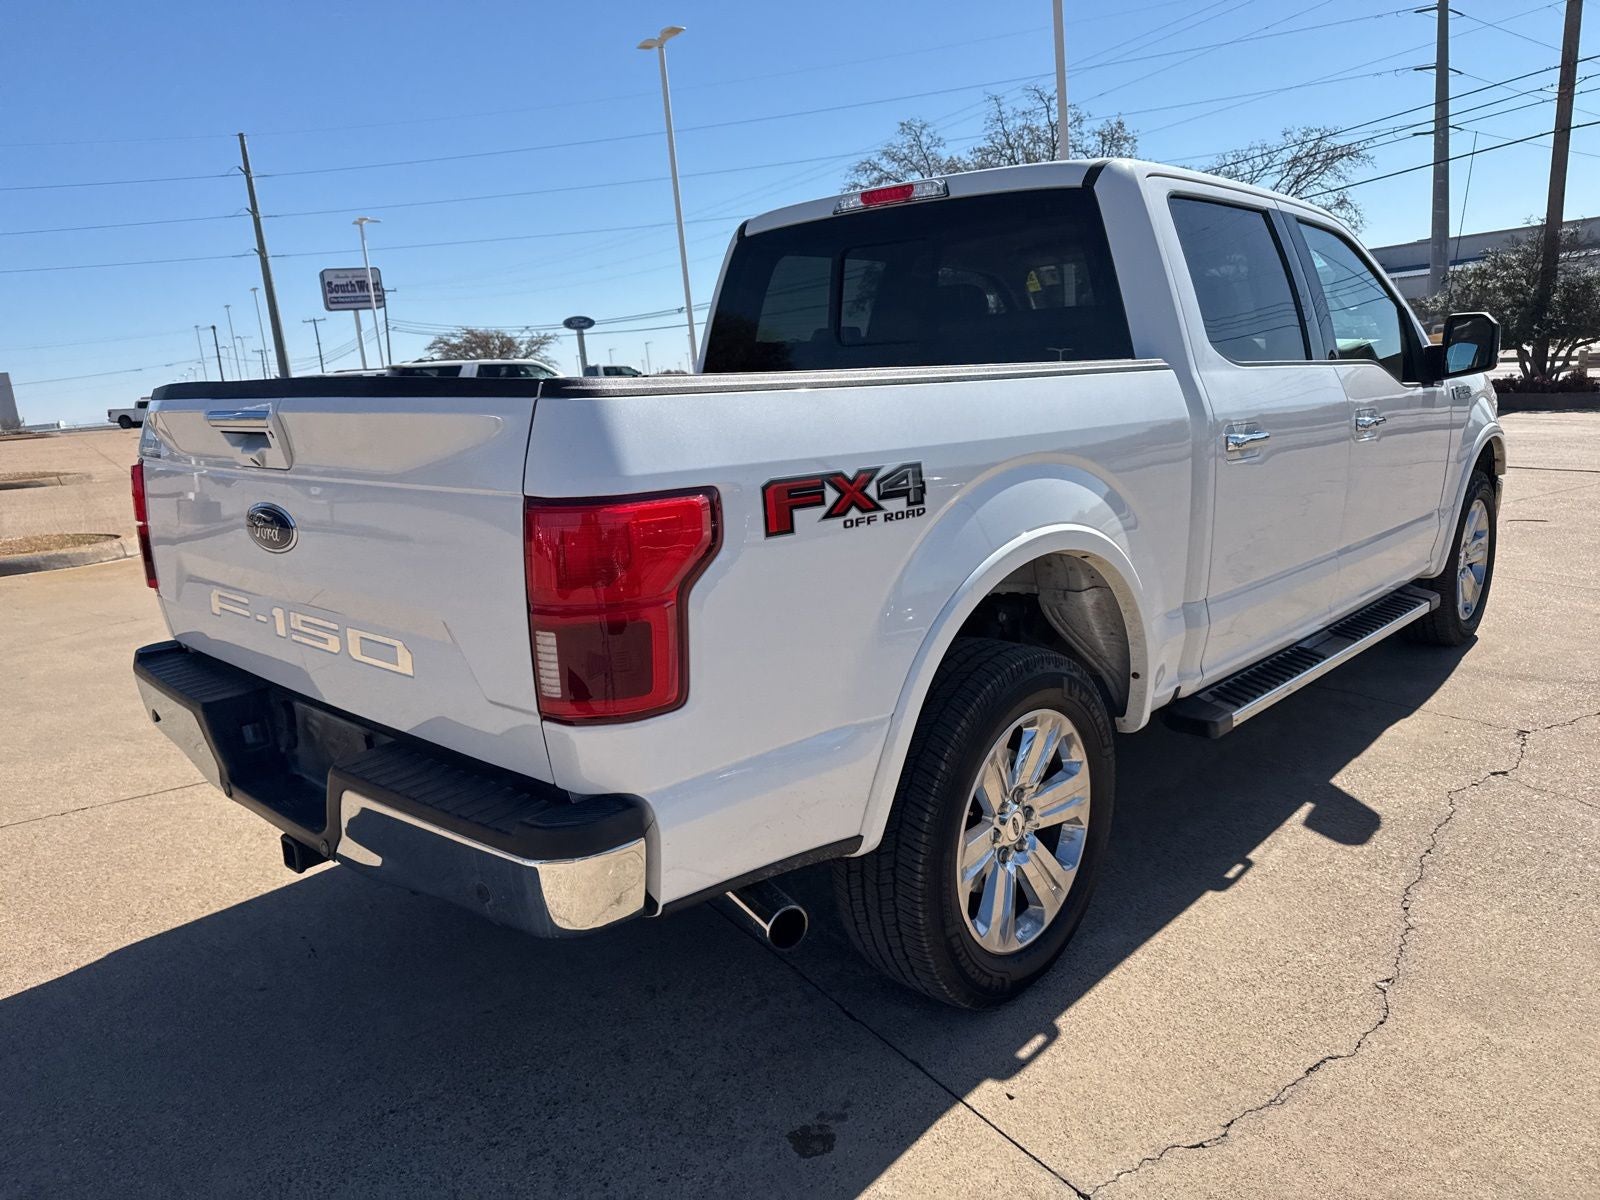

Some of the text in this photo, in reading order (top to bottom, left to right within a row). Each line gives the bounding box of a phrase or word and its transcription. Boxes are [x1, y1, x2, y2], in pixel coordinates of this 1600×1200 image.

[252, 512, 280, 542] Ford
[761, 461, 926, 539] FX4
[843, 507, 926, 529] OFF ROAD
[210, 589, 414, 677] F-150
